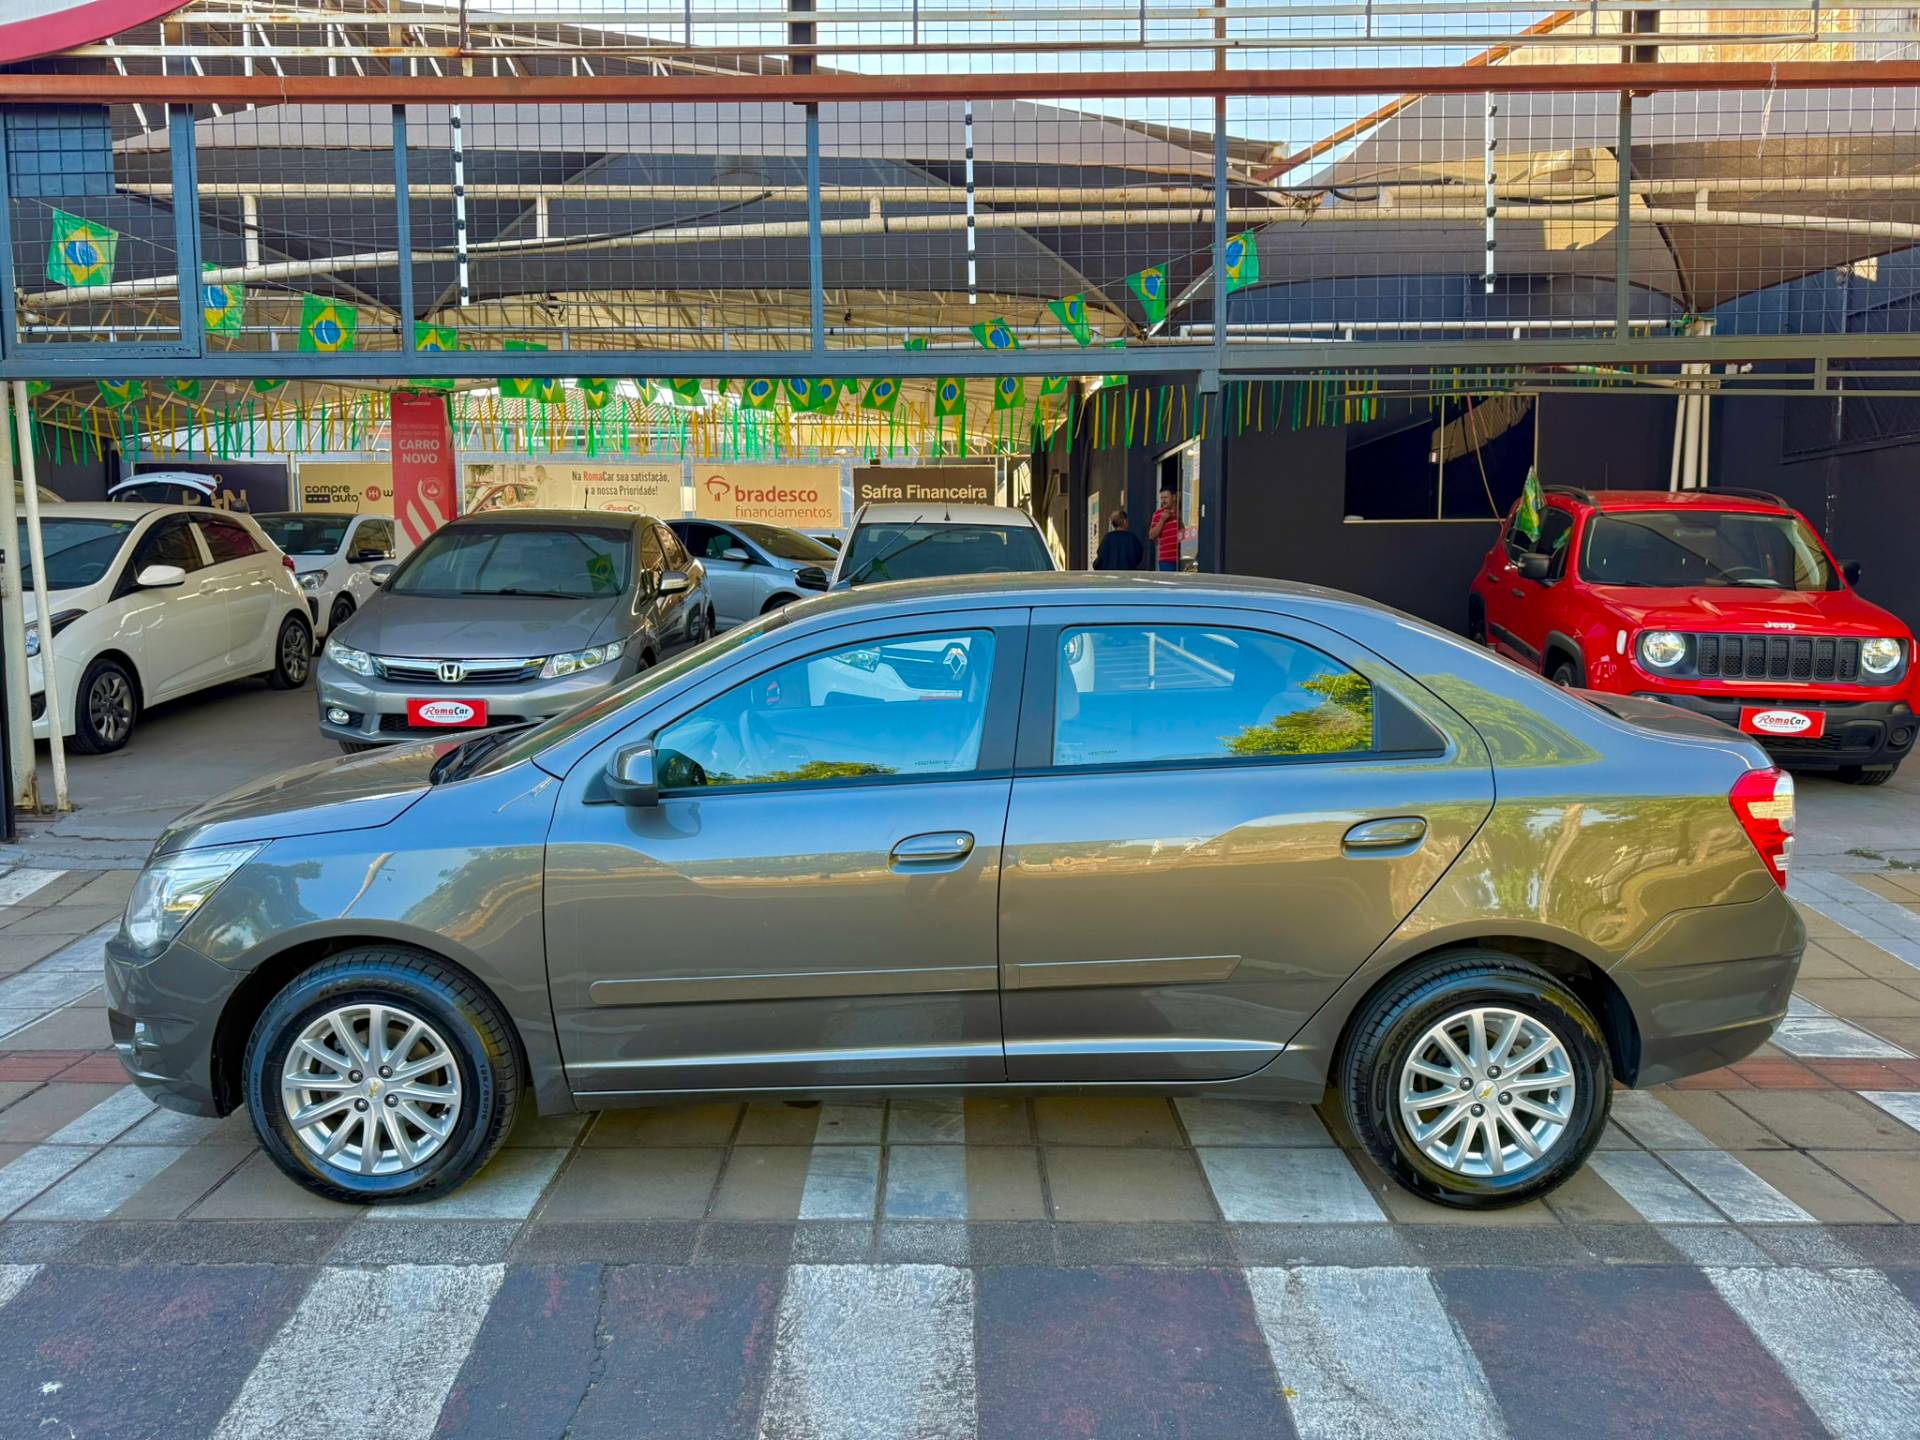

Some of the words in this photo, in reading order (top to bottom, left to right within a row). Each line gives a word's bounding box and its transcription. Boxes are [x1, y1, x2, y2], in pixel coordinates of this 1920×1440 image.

[399, 439, 440, 450] CARRO
[402, 453, 438, 464] NOVO
[572, 471, 582, 481] Na
[583, 471, 615, 481] RomaCar
[616, 473, 629, 482] sua
[304, 484, 351, 495] compre
[596, 487, 618, 496] nossa
[619, 485, 659, 496] Prioridade!
[735, 485, 818, 502] bradesco
[861, 484, 902, 499] Safra
[906, 484, 987, 499] Financeira
[331, 493, 359, 503] auto
[735, 505, 833, 518] financiamentos
[1763, 620, 1796, 631] Jeep
[424, 706, 469, 715] RomaCar
[1758, 715, 1806, 726] RomaCar
